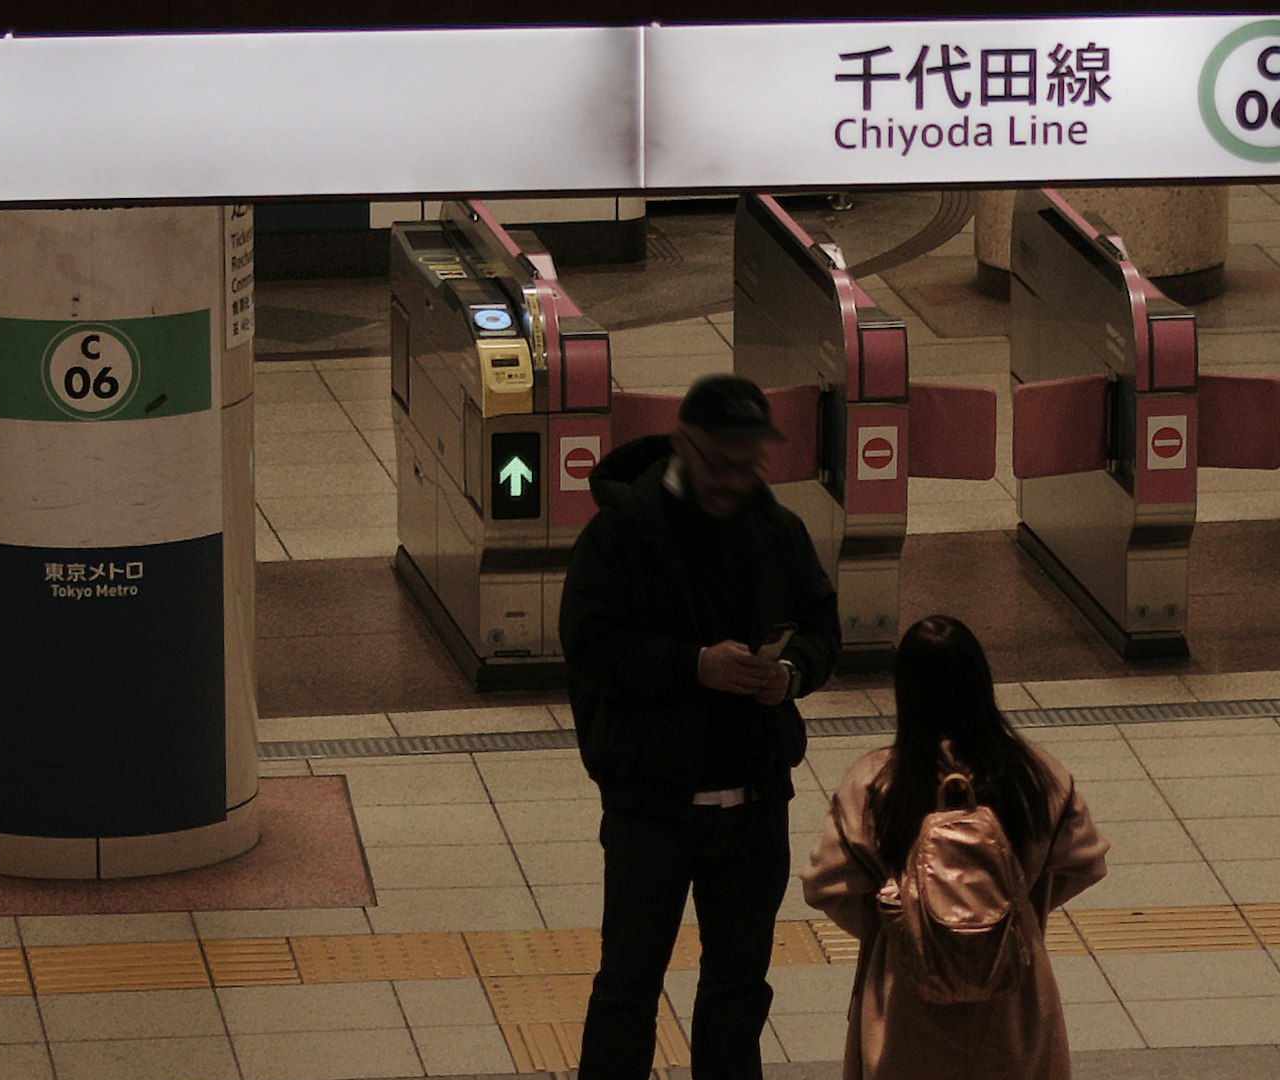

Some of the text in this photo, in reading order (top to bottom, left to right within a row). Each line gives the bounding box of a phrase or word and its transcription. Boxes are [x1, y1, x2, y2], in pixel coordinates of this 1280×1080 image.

[835, 42, 1112, 111] 千代田線
[1236, 89, 1280, 131] 0
[834, 115, 1089, 156] Chiyoda Line
[81, 334, 101, 360] C
[64, 366, 119, 400] 06
[44, 562, 143, 581] 東京メトロ
[51, 583, 138, 600] Tokyo Metro
